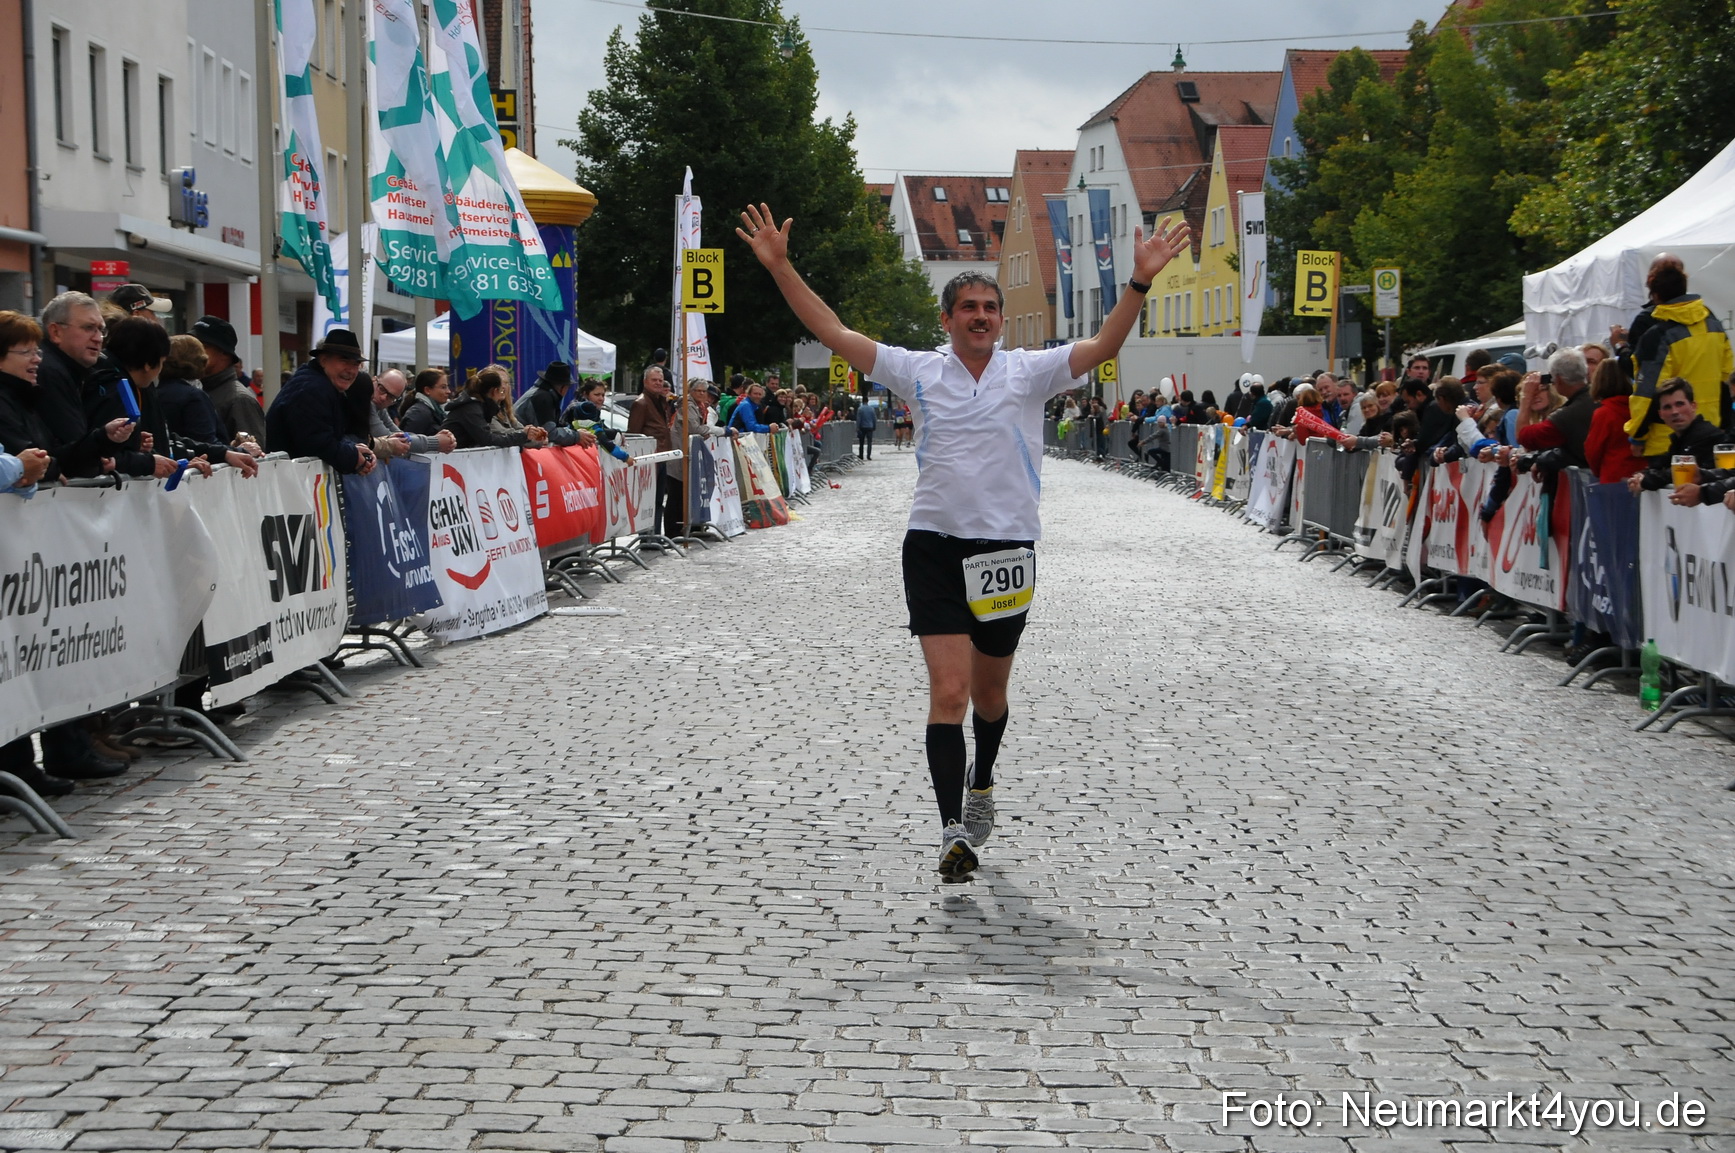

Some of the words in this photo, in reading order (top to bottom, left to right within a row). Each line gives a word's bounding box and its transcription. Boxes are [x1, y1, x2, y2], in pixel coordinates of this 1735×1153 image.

[458, 211, 510, 225] etservice
[686, 251, 720, 263] Block
[1302, 254, 1335, 266] Block
[508, 275, 543, 300] 6352
[693, 268, 714, 299] B
[1306, 270, 1328, 302] B
[834, 364, 844, 378] C
[1103, 362, 1113, 376] C
[965, 561, 990, 570] PARTL
[991, 555, 1025, 566] Neumarkt
[0, 542, 127, 627] ntDynamics
[980, 565, 1024, 595] 290
[991, 596, 1017, 610] Josef
[50, 616, 127, 670] Fahrfreude.
